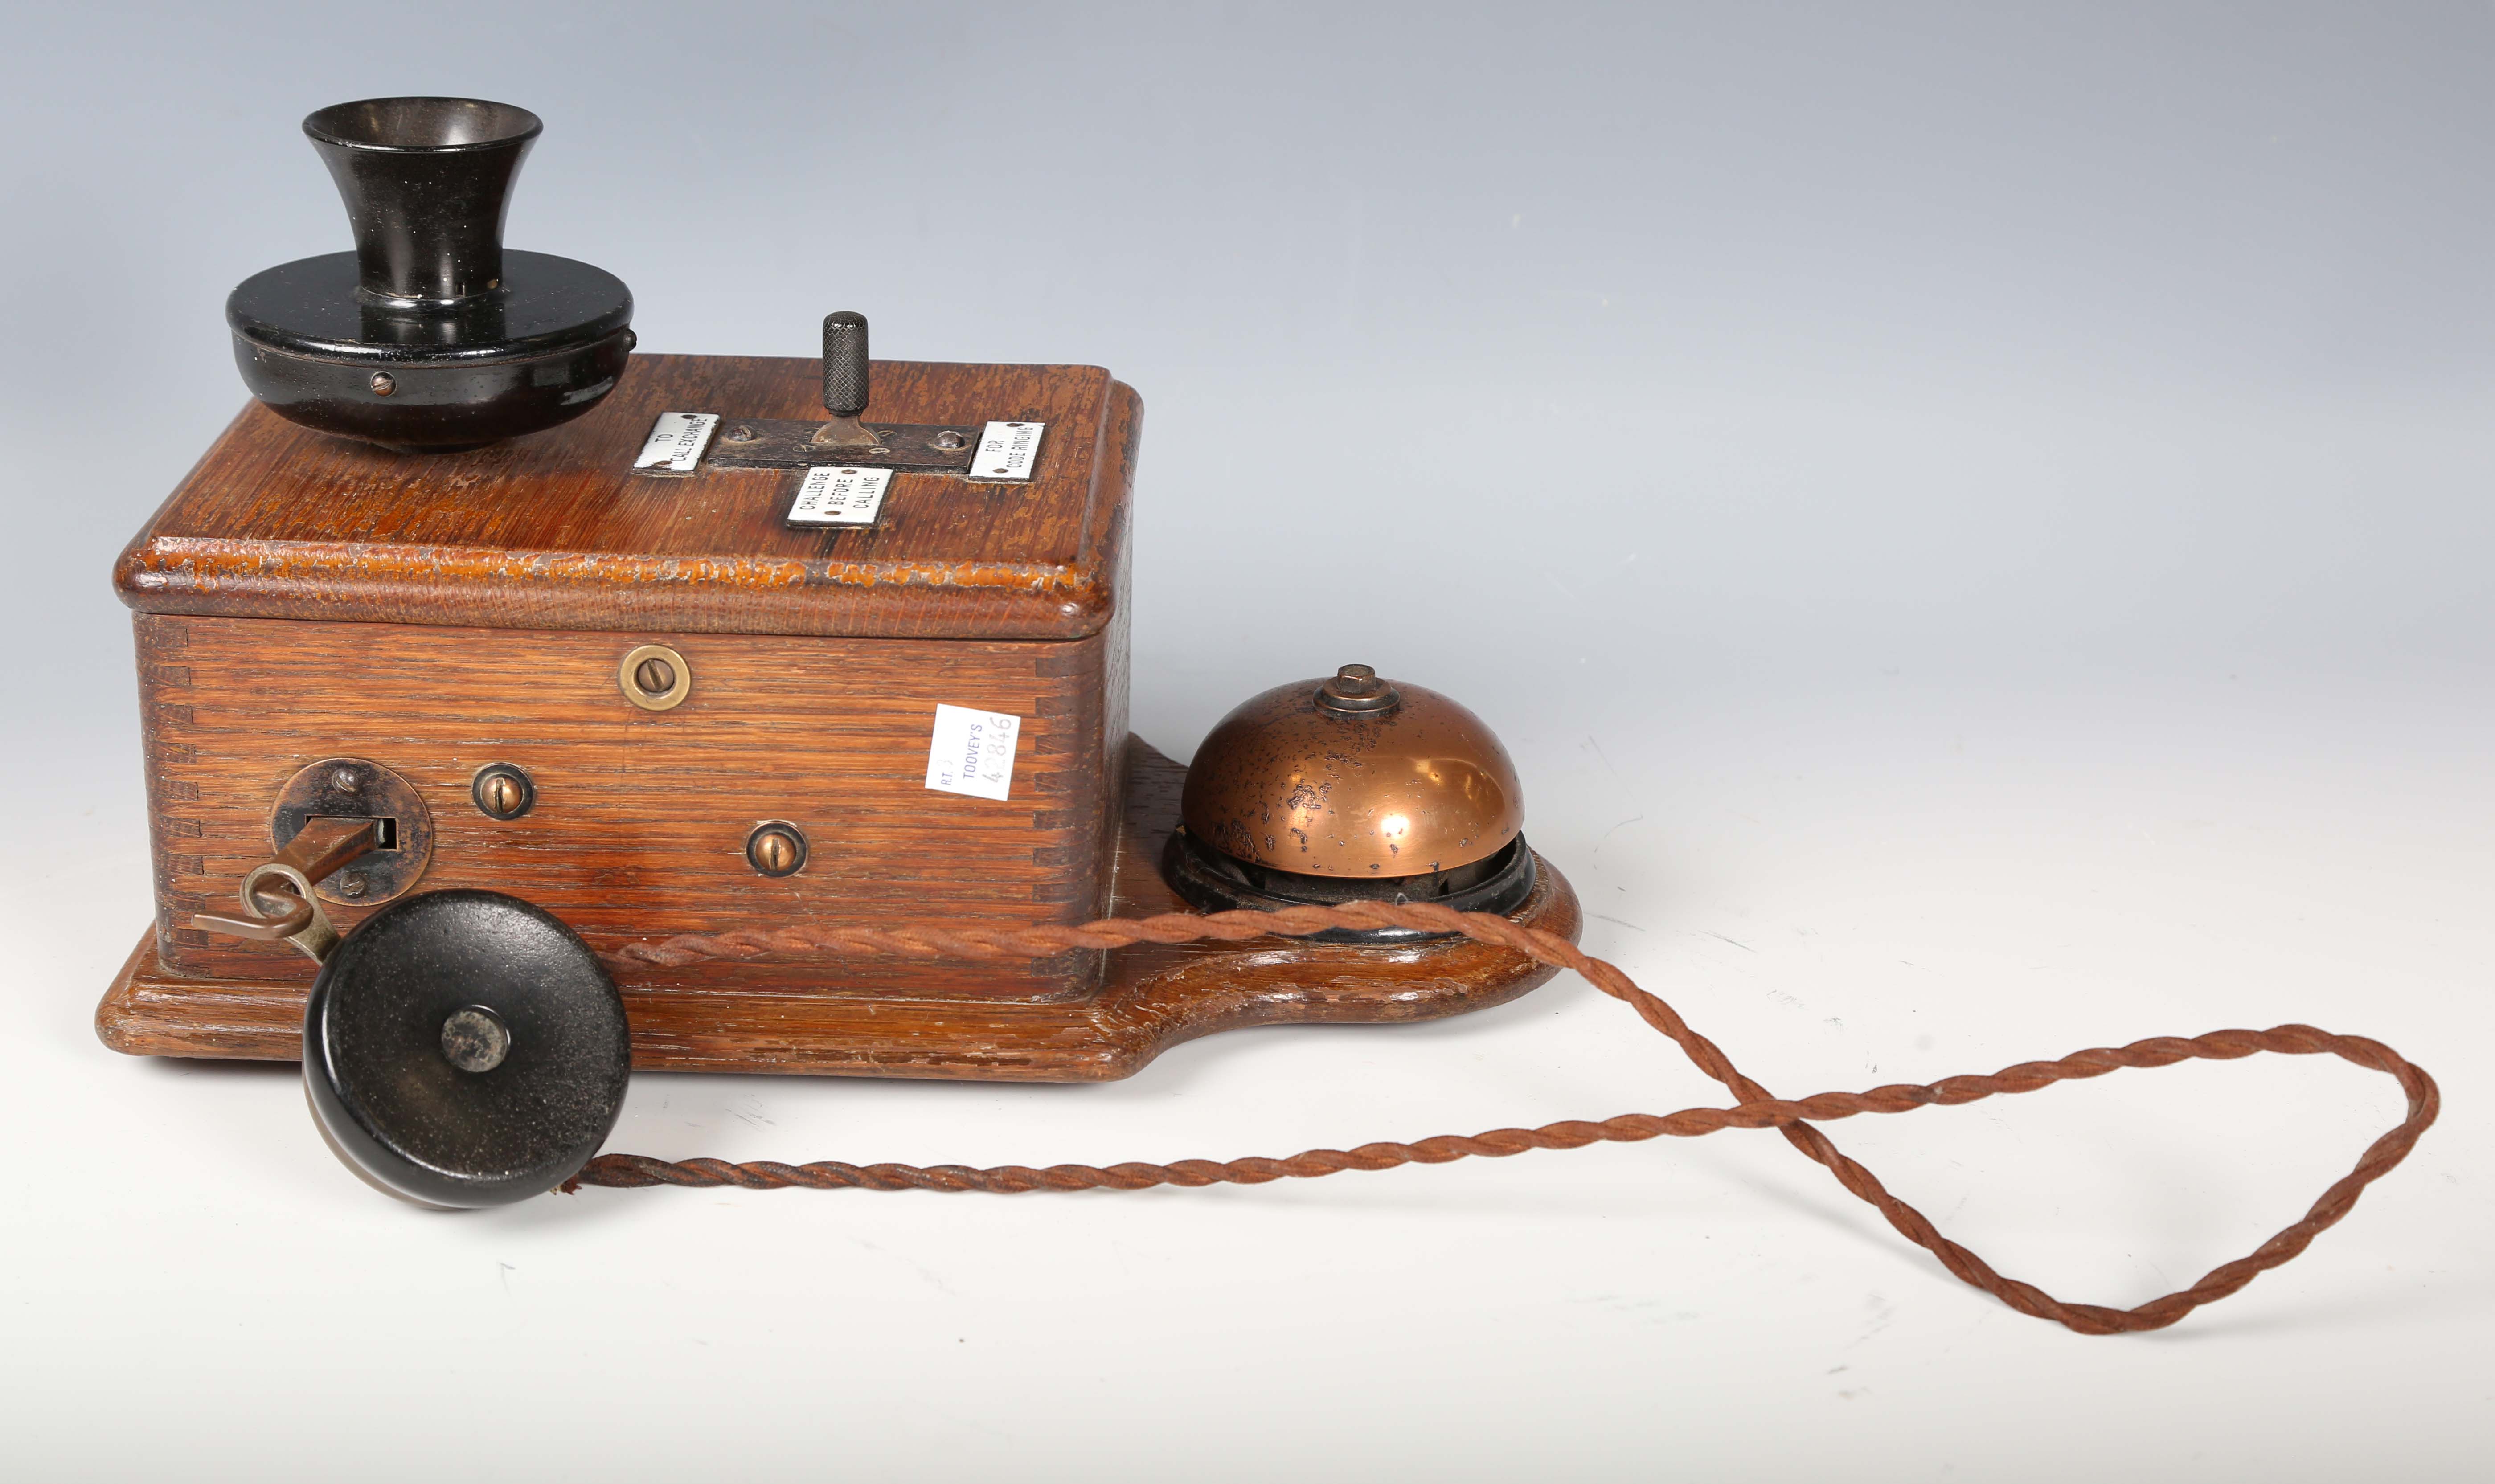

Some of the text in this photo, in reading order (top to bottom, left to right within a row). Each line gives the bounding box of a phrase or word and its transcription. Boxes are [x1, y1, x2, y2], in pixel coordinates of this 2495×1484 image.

[655, 433, 673, 442] TO
[670, 417, 708, 461] CALL EXCHANGE
[985, 440, 1005, 452] FOR
[1006, 427, 1034, 468] CODE RINGING
[799, 472, 831, 510] CHALLENGE
[828, 478, 853, 505] BEFORE
[852, 477, 880, 509] CALLING
[963, 724, 983, 780] TOOVEY'S
